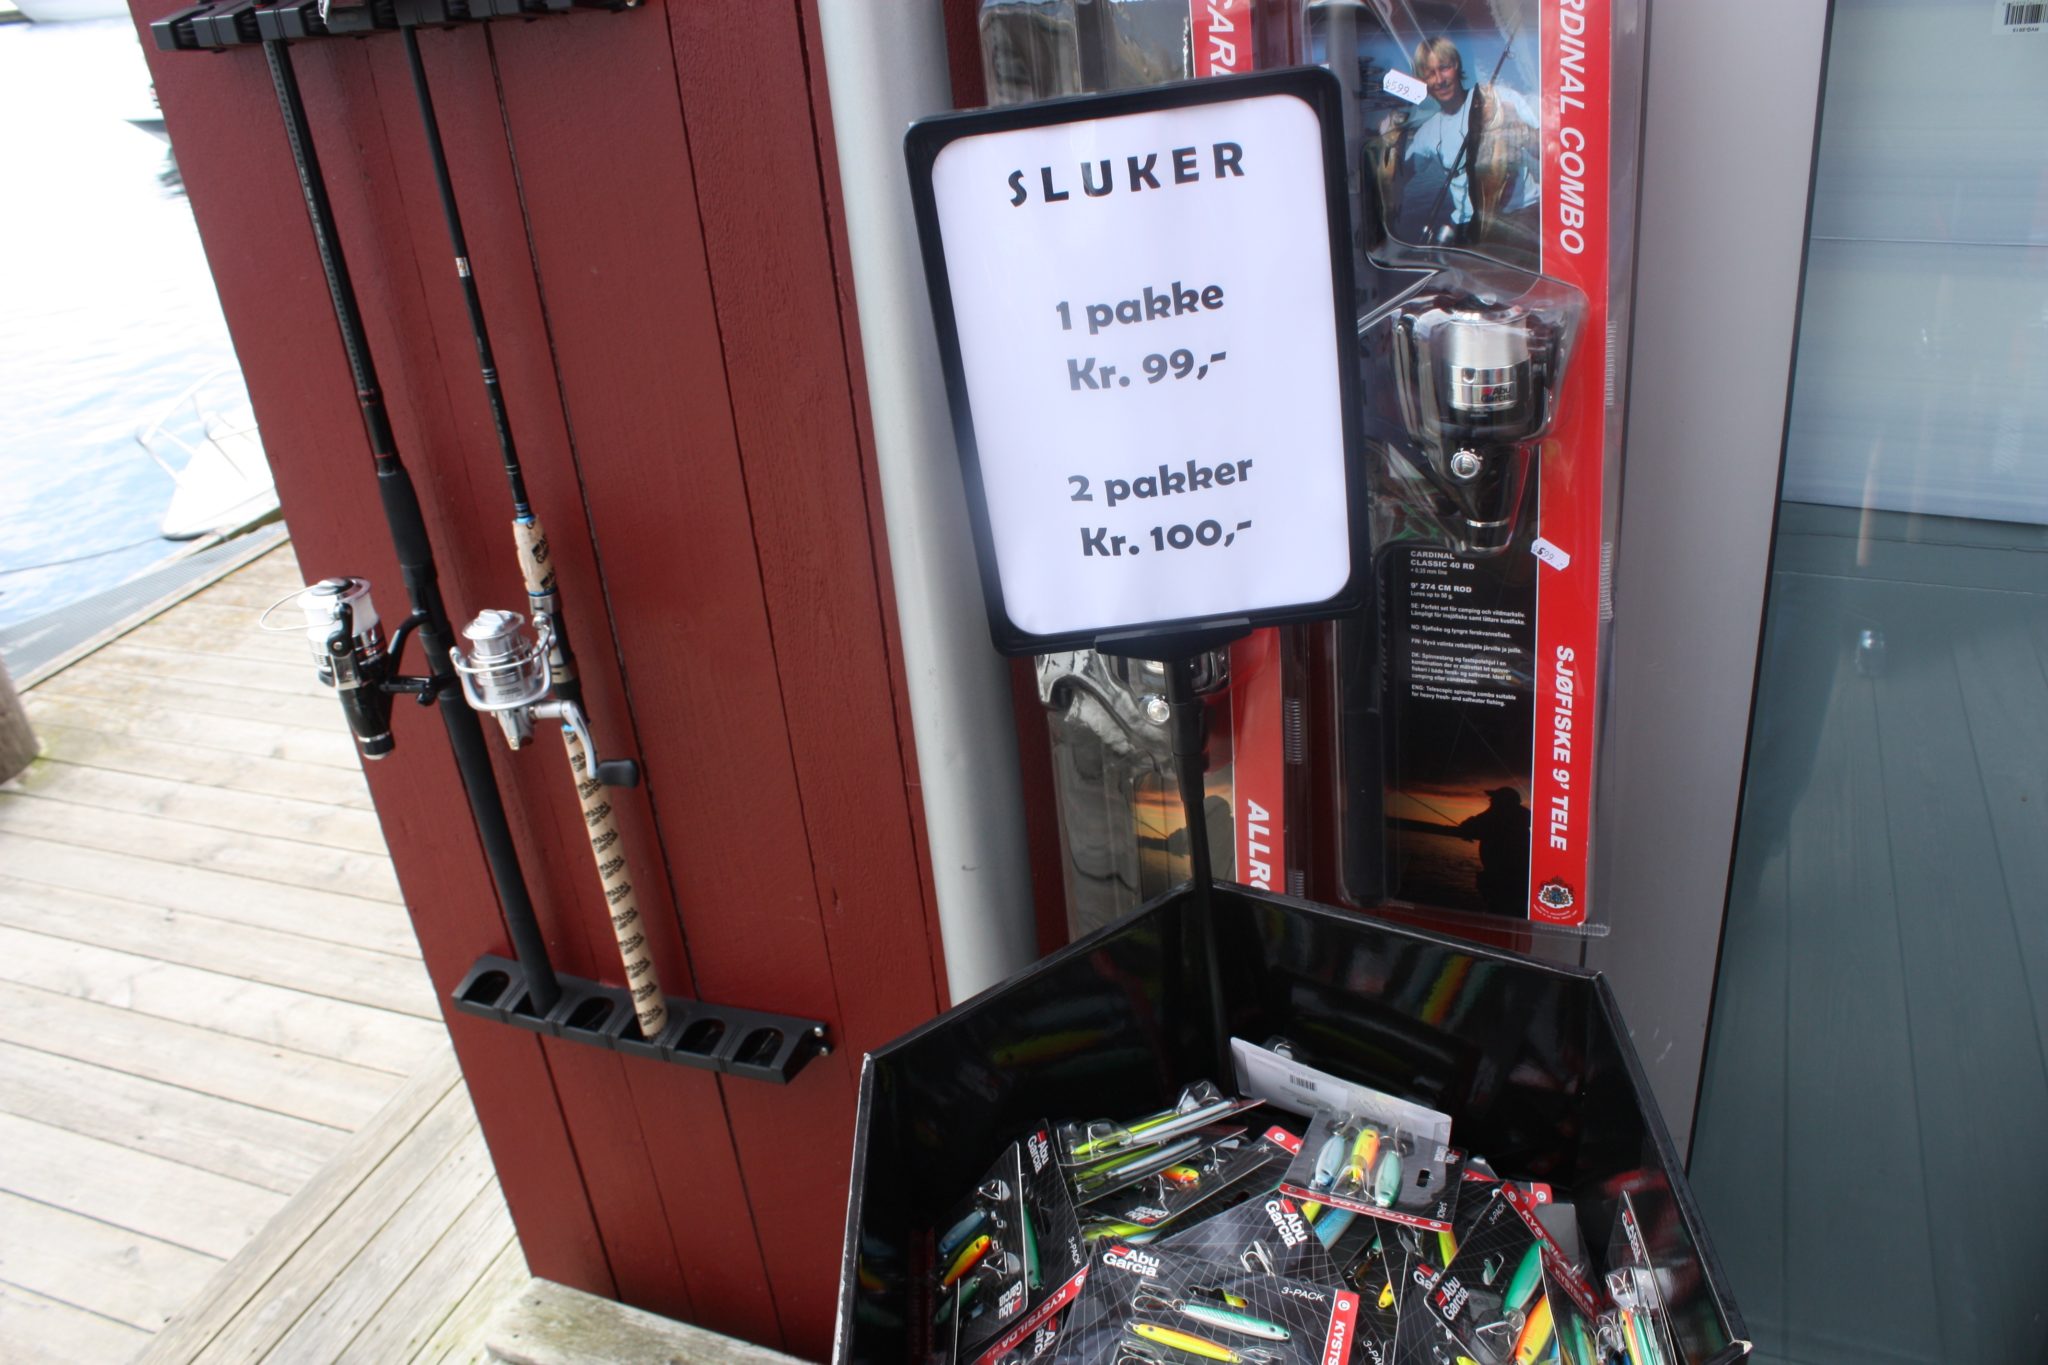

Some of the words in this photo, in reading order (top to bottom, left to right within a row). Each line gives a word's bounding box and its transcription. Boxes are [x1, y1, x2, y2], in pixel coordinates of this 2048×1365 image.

[1207, 0, 1236, 76] AR
[1008, 142, 1245, 208] SLUKER
[1560, 127, 1585, 254] COMBO
[1056, 300, 1072, 330] 1
[1086, 281, 1224, 335] pakke
[1066, 357, 1130, 390] Kr.
[1142, 348, 1226, 384] 99,-
[1068, 474, 1093, 502] 2
[1104, 458, 1253, 507] pakker
[1080, 526, 1140, 556] Kr.
[1150, 518, 1252, 551] 100,-
[1410, 551, 1455, 560] CARDINAL
[1410, 560, 1448, 568] CLASSIC
[1554, 646, 1575, 764] SJØFISKE
[1552, 768, 1570, 790] 9'
[1550, 795, 1569, 851] TELE
[1038, 1140, 1049, 1165] Abu
[1266, 1200, 1296, 1247] Garcia
[1283, 1213, 1308, 1242] Abu
[1103, 1252, 1156, 1276] Garcia
[1125, 1249, 1160, 1268] Abu
[1281, 1286, 1325, 1301] 3-PACK
[1442, 1276, 1460, 1301] Abu
[1443, 1287, 1469, 1320] Garcia
